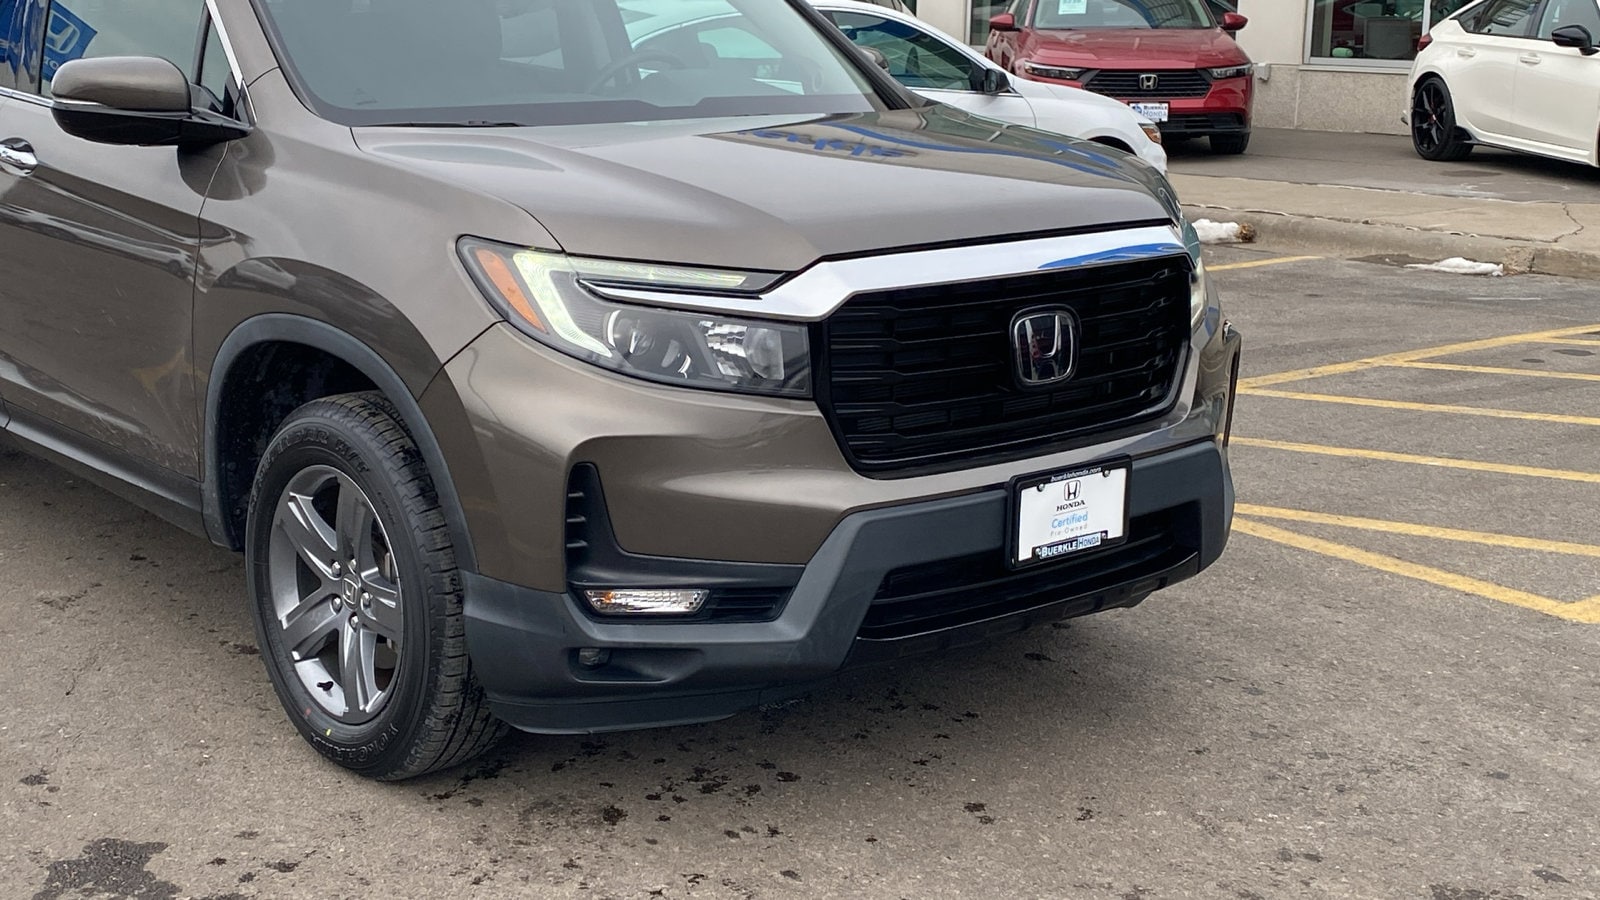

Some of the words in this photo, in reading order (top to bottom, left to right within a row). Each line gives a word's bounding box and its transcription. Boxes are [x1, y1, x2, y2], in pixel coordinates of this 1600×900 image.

[1056, 499, 1086, 511] HONDA
[1051, 510, 1088, 529] Certified
[1040, 541, 1078, 558] BUERKLE
[1078, 535, 1100, 548] HONDA
